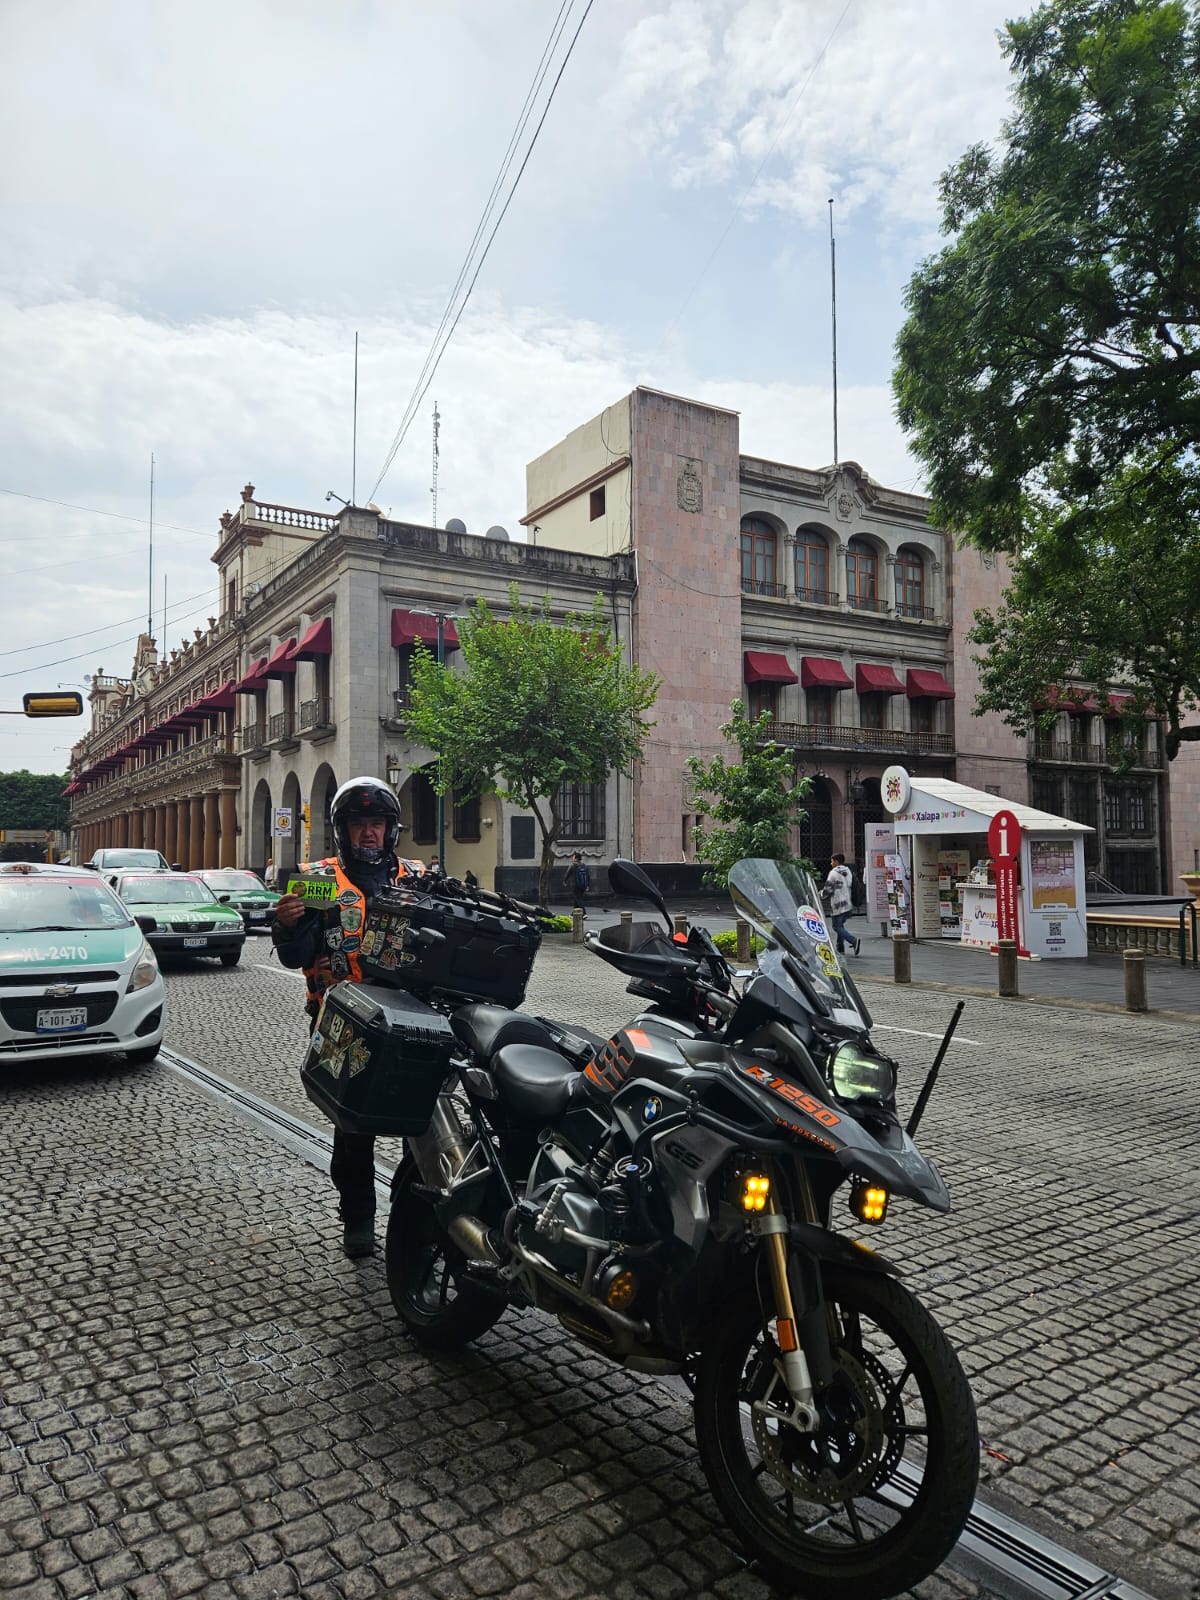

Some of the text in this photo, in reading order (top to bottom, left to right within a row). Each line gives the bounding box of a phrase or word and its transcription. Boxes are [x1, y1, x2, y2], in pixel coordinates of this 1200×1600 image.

[915, 811, 940, 823] Xalapa
[998, 817, 1010, 857] i
[308, 885, 332, 897] RRM
[22, 945, 88, 962] XL-2470
[665, 1141, 704, 1170] GS
